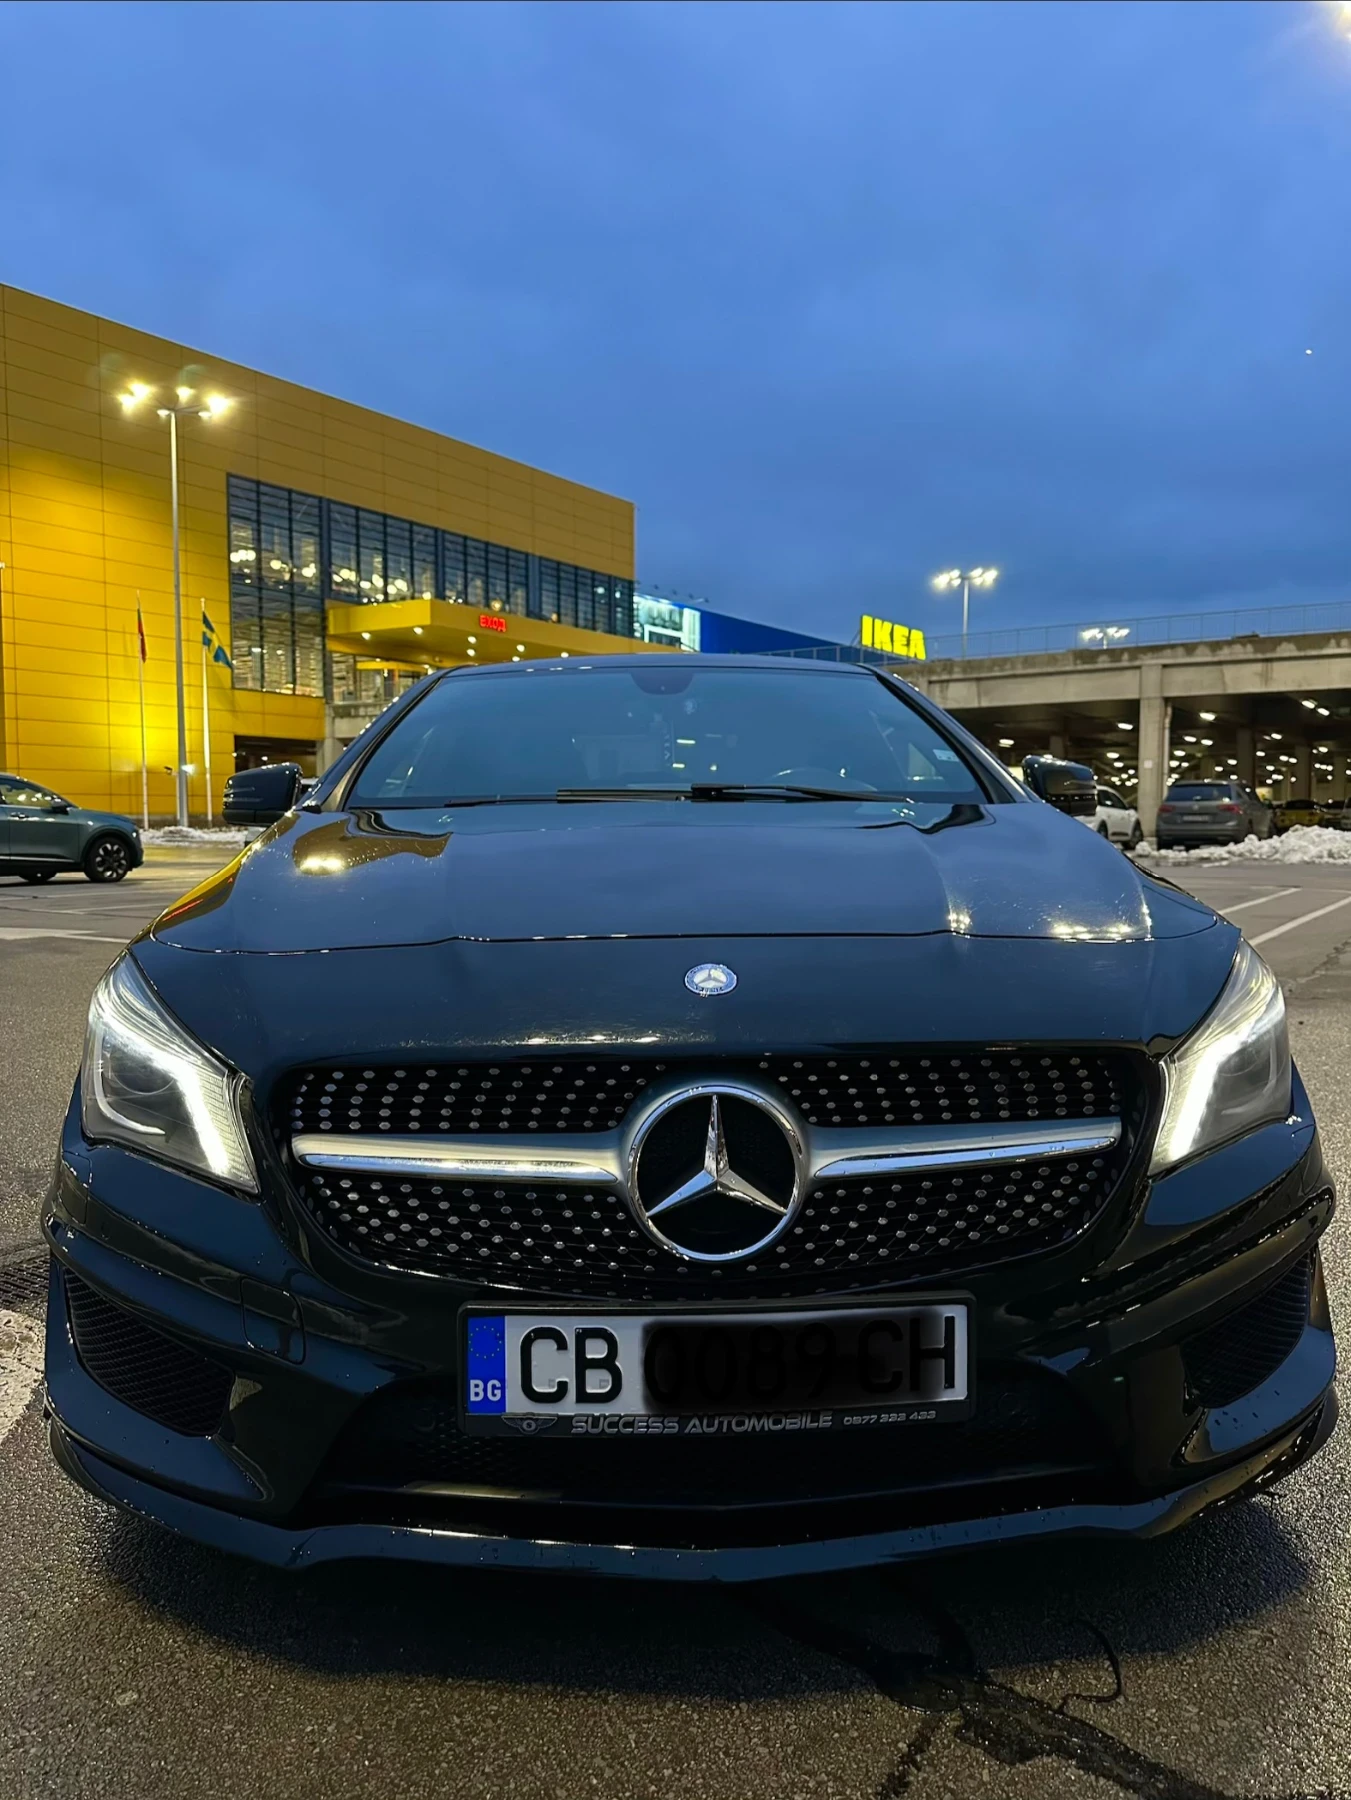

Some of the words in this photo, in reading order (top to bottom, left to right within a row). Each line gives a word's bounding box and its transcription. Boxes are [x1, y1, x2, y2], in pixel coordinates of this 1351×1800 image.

[861, 614, 926, 660] IKEA
[520, 1326, 623, 1403] CB
[469, 1379, 502, 1401] BG
[571, 1416, 680, 1434] SUCCESS
[685, 1410, 833, 1434] AUTOMOBILE
